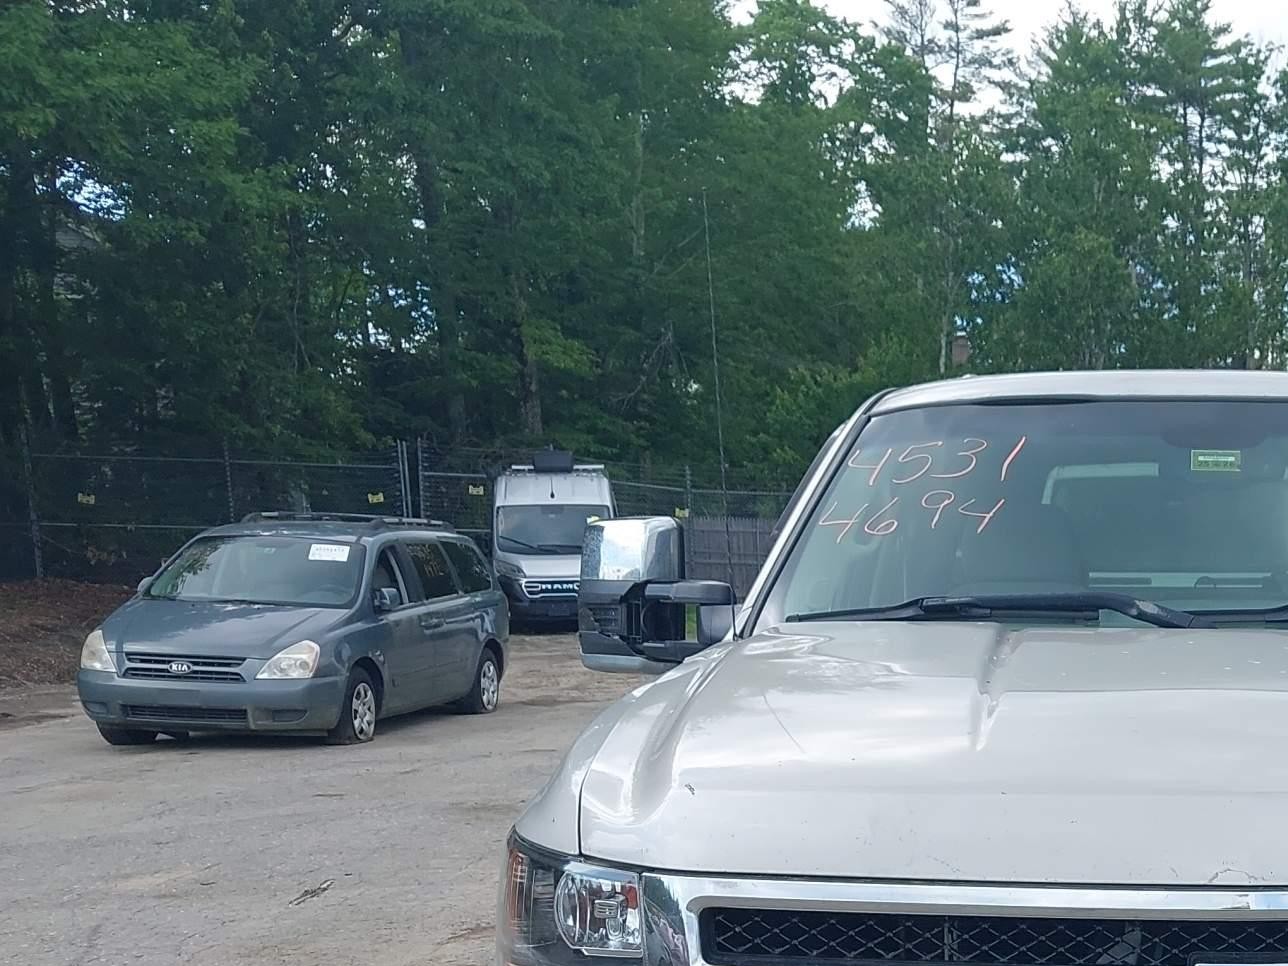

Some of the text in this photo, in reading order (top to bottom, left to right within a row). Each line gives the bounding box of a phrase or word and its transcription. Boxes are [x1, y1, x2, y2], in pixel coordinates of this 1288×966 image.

[847, 435, 1027, 487] 4531
[818, 489, 1006, 545] 4694
[541, 582, 573, 590] RAM
[172, 662, 188, 671] KIA
